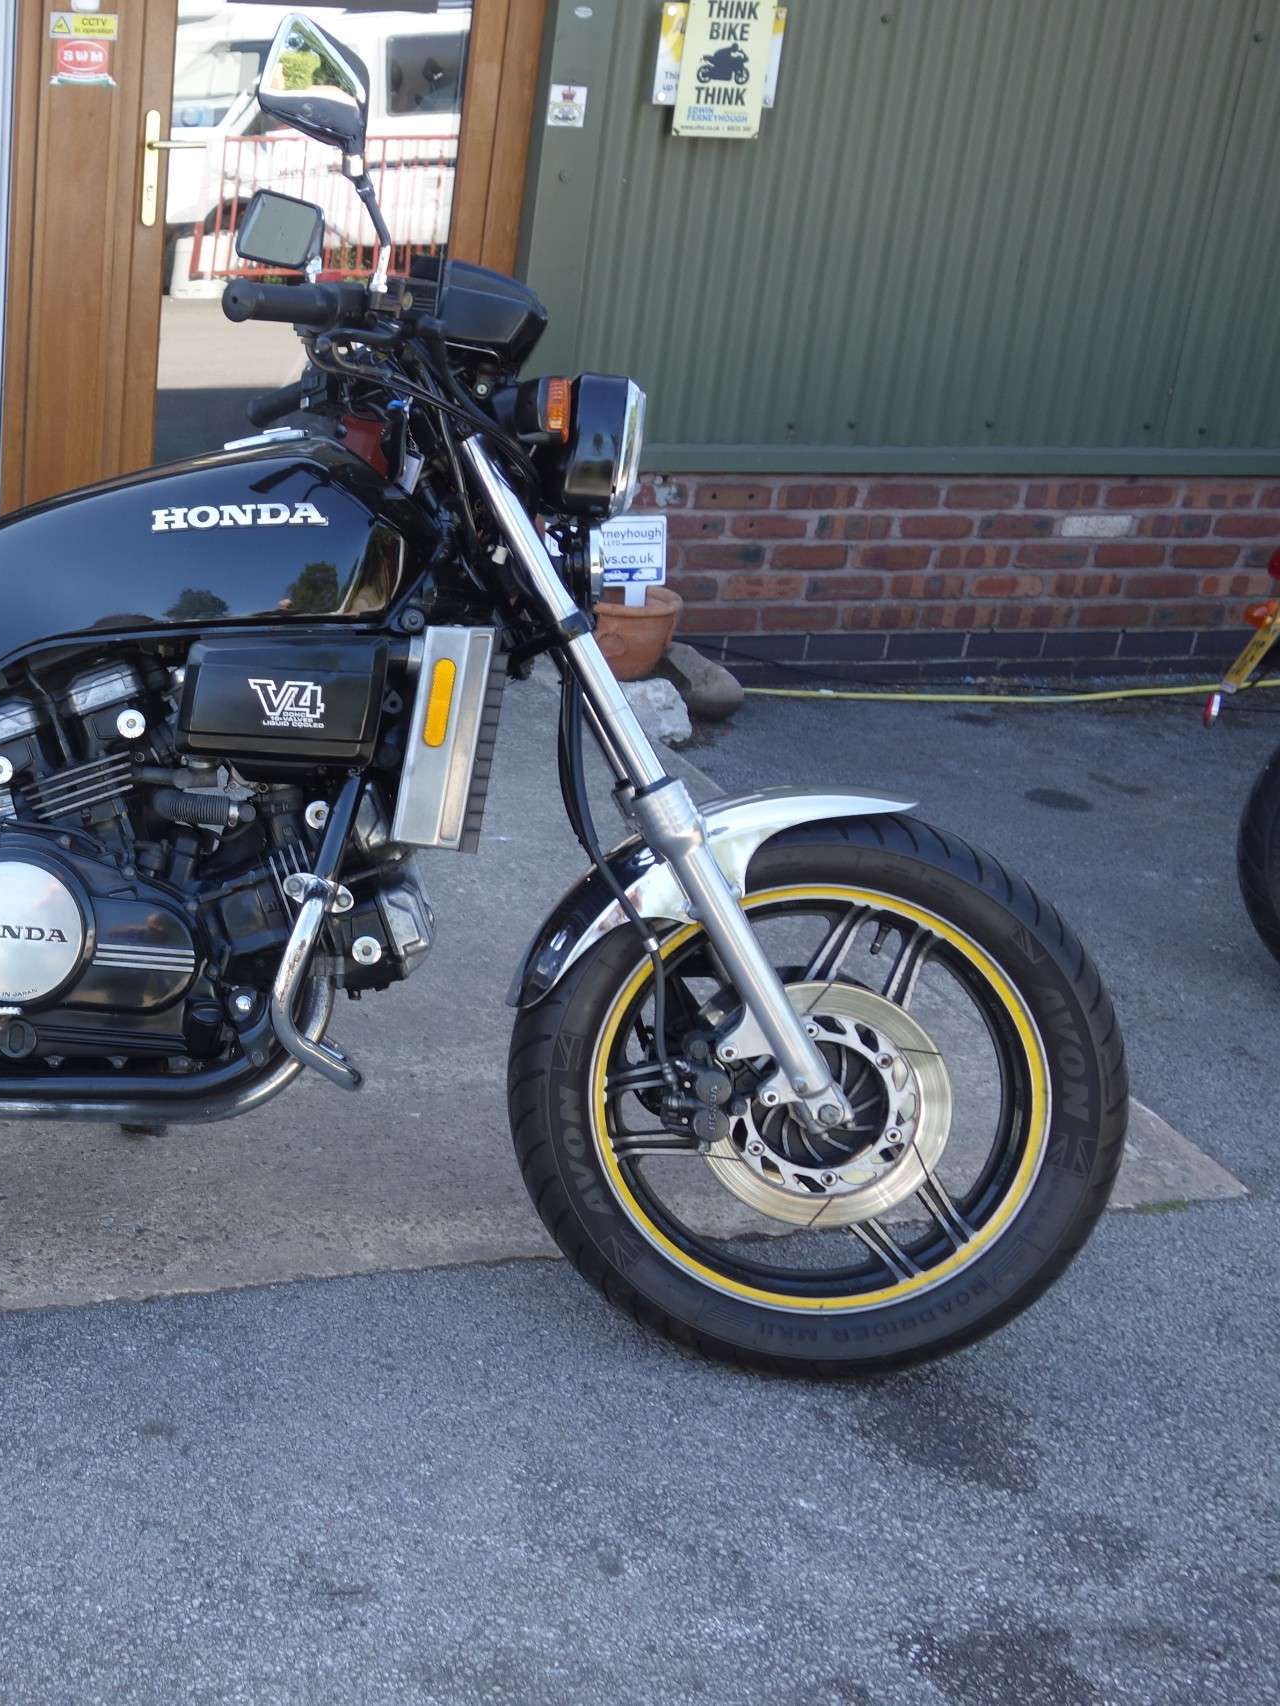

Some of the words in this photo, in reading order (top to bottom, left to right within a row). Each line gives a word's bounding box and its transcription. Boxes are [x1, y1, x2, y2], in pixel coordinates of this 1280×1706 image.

[707, 0, 760, 20] THINK
[81, 17, 107, 27] CCTV
[709, 22, 750, 41] BIKE
[695, 86, 747, 106] THINK
[152, 502, 329, 533] HONDA
[248, 678, 325, 718] V4
[12, 988, 38, 997] JAPAN
[1045, 992, 1090, 1123] AVON
[567, 1089, 613, 1215] AVON
